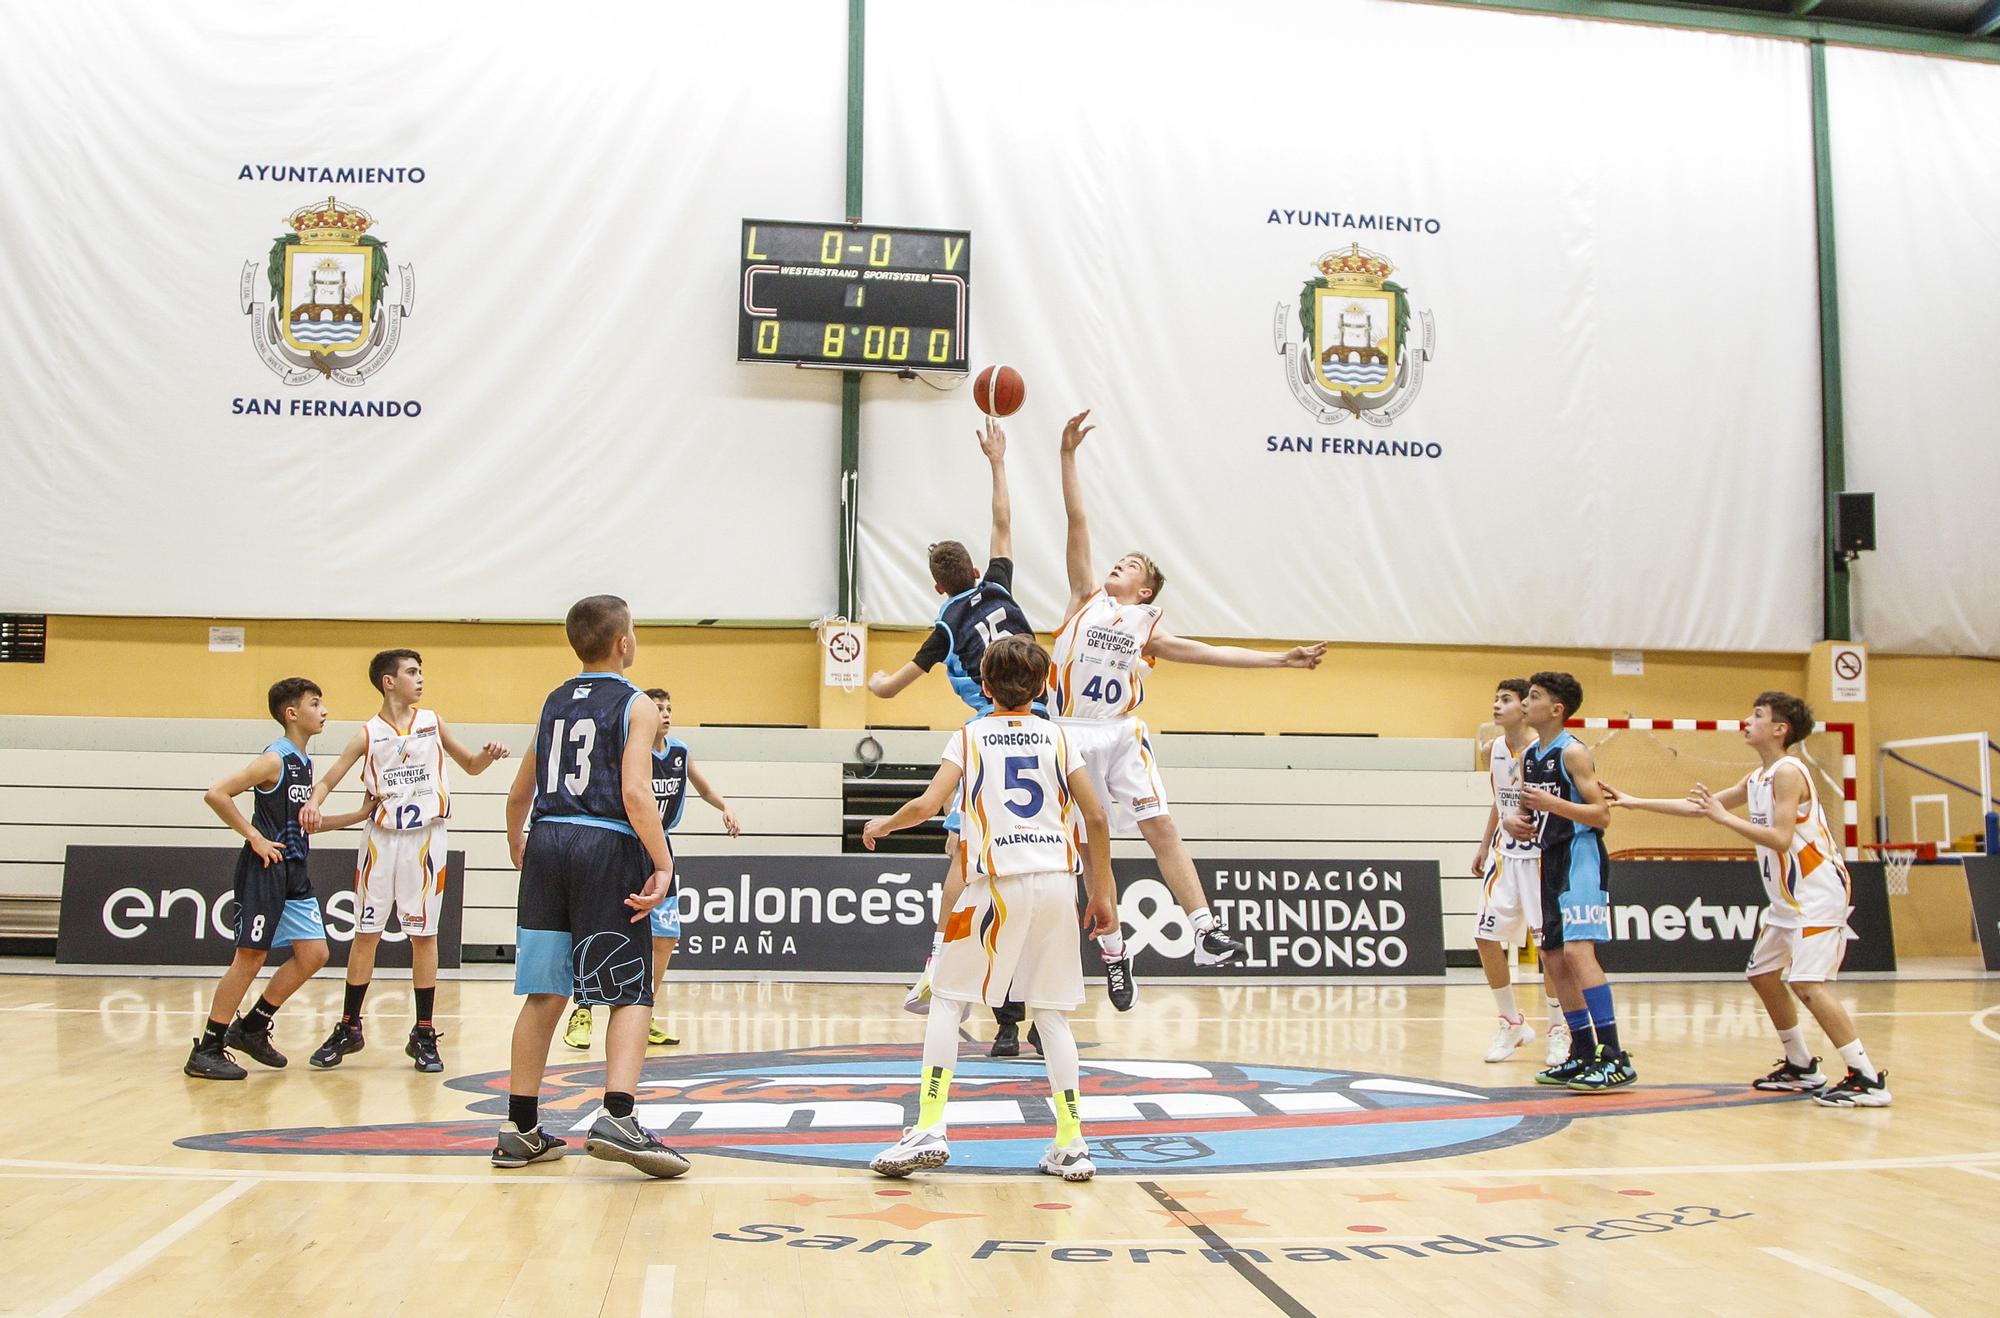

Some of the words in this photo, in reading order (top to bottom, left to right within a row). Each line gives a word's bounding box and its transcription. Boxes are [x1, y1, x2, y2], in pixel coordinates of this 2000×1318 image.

[238, 164, 426, 184] AYUNTAMIENTO
[1267, 209, 1441, 234] AYUNTAMIENTO
[747, 227, 767, 260] L
[944, 237, 964, 270] V
[780, 266, 859, 278] WESTERSTRAND
[863, 271, 930, 282] SPORTSYSTEM
[757, 320, 780, 354] 0
[927, 328, 950, 362] 0
[231, 397, 281, 416] SAN
[290, 399, 422, 418] FERNANDO
[1266, 435, 1313, 453] SAN
[1321, 437, 1443, 459] FERNANDO
[1086, 629, 1135, 649] COMUNITAT
[1087, 638, 1099, 648] DE
[1082, 675, 1122, 704] 40
[545, 718, 597, 796] 13
[383, 767, 425, 781] COMUNITA
[387, 778, 398, 787] DE
[1004, 755, 1044, 819] 5
[396, 804, 422, 829] 12
[994, 833, 1063, 847] VALENCIANA
[1215, 867, 1402, 892] FUNDACIÓN
[675, 872, 945, 925] baloncest
[102, 887, 408, 942] ens
[1213, 899, 1406, 932] TRINIDAD
[250, 914, 266, 942] 8
[1217, 936, 1408, 967] LFONSO
[928, 1078, 941, 1100] NIKE
[712, 1223, 934, 1257] San
[970, 1233, 1560, 1264] Fernando
[1553, 1205, 1754, 1240] 2022
